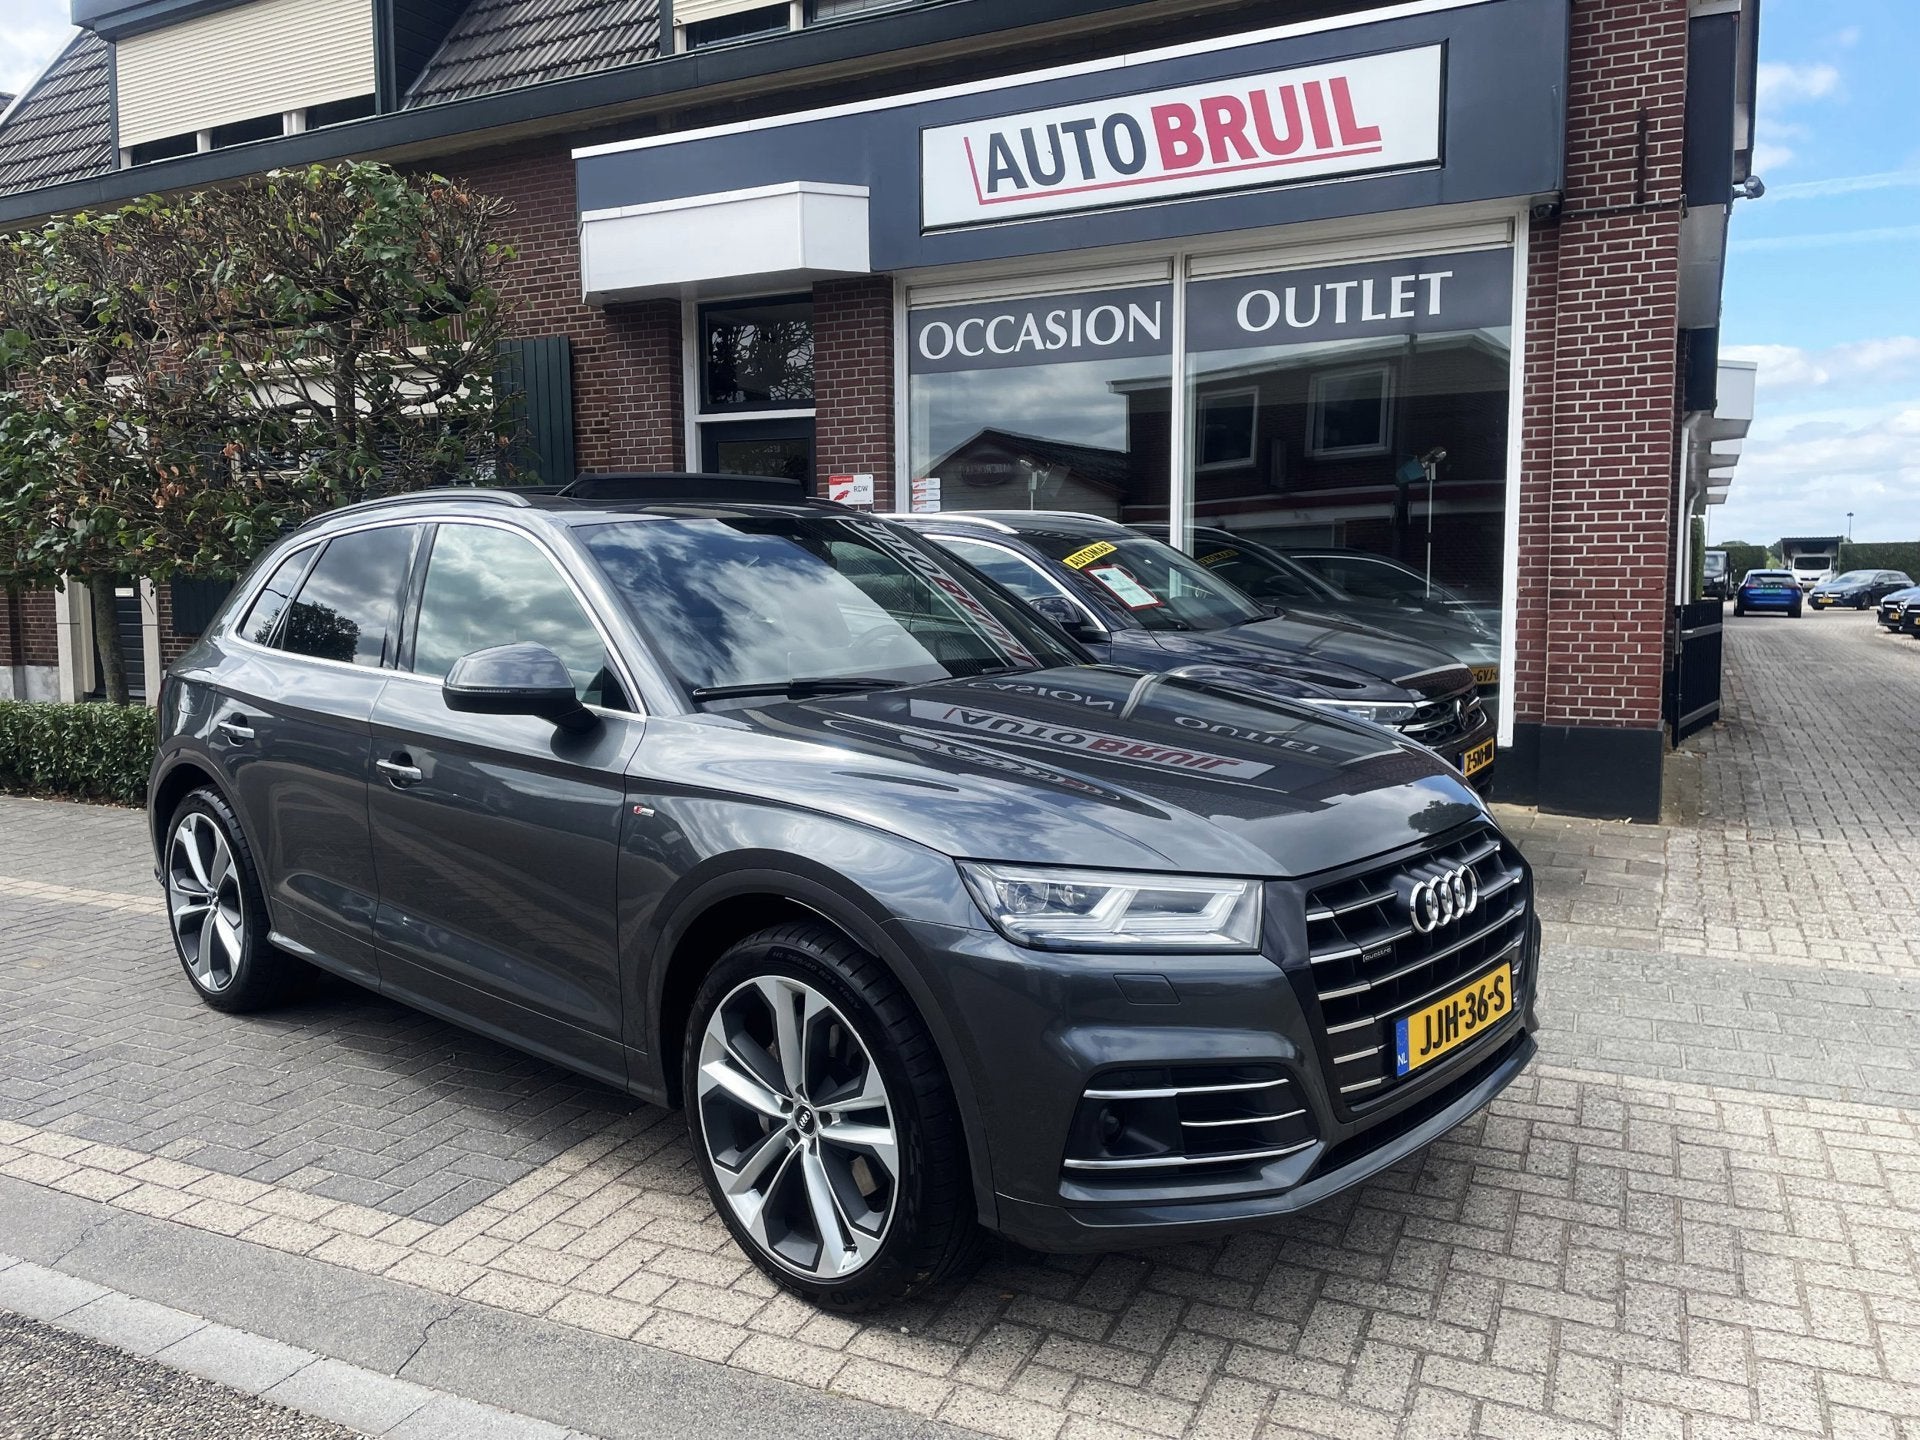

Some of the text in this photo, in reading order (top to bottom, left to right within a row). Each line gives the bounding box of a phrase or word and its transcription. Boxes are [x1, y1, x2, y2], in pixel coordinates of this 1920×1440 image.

[919, 271, 1454, 360] OCCASION OUTLET
[853, 485, 869, 493] RDW
[1069, 542, 1113, 567] AUTOMAAT
[1420, 975, 1505, 1056] JJH-36-S
[1397, 1052, 1408, 1066] NL
